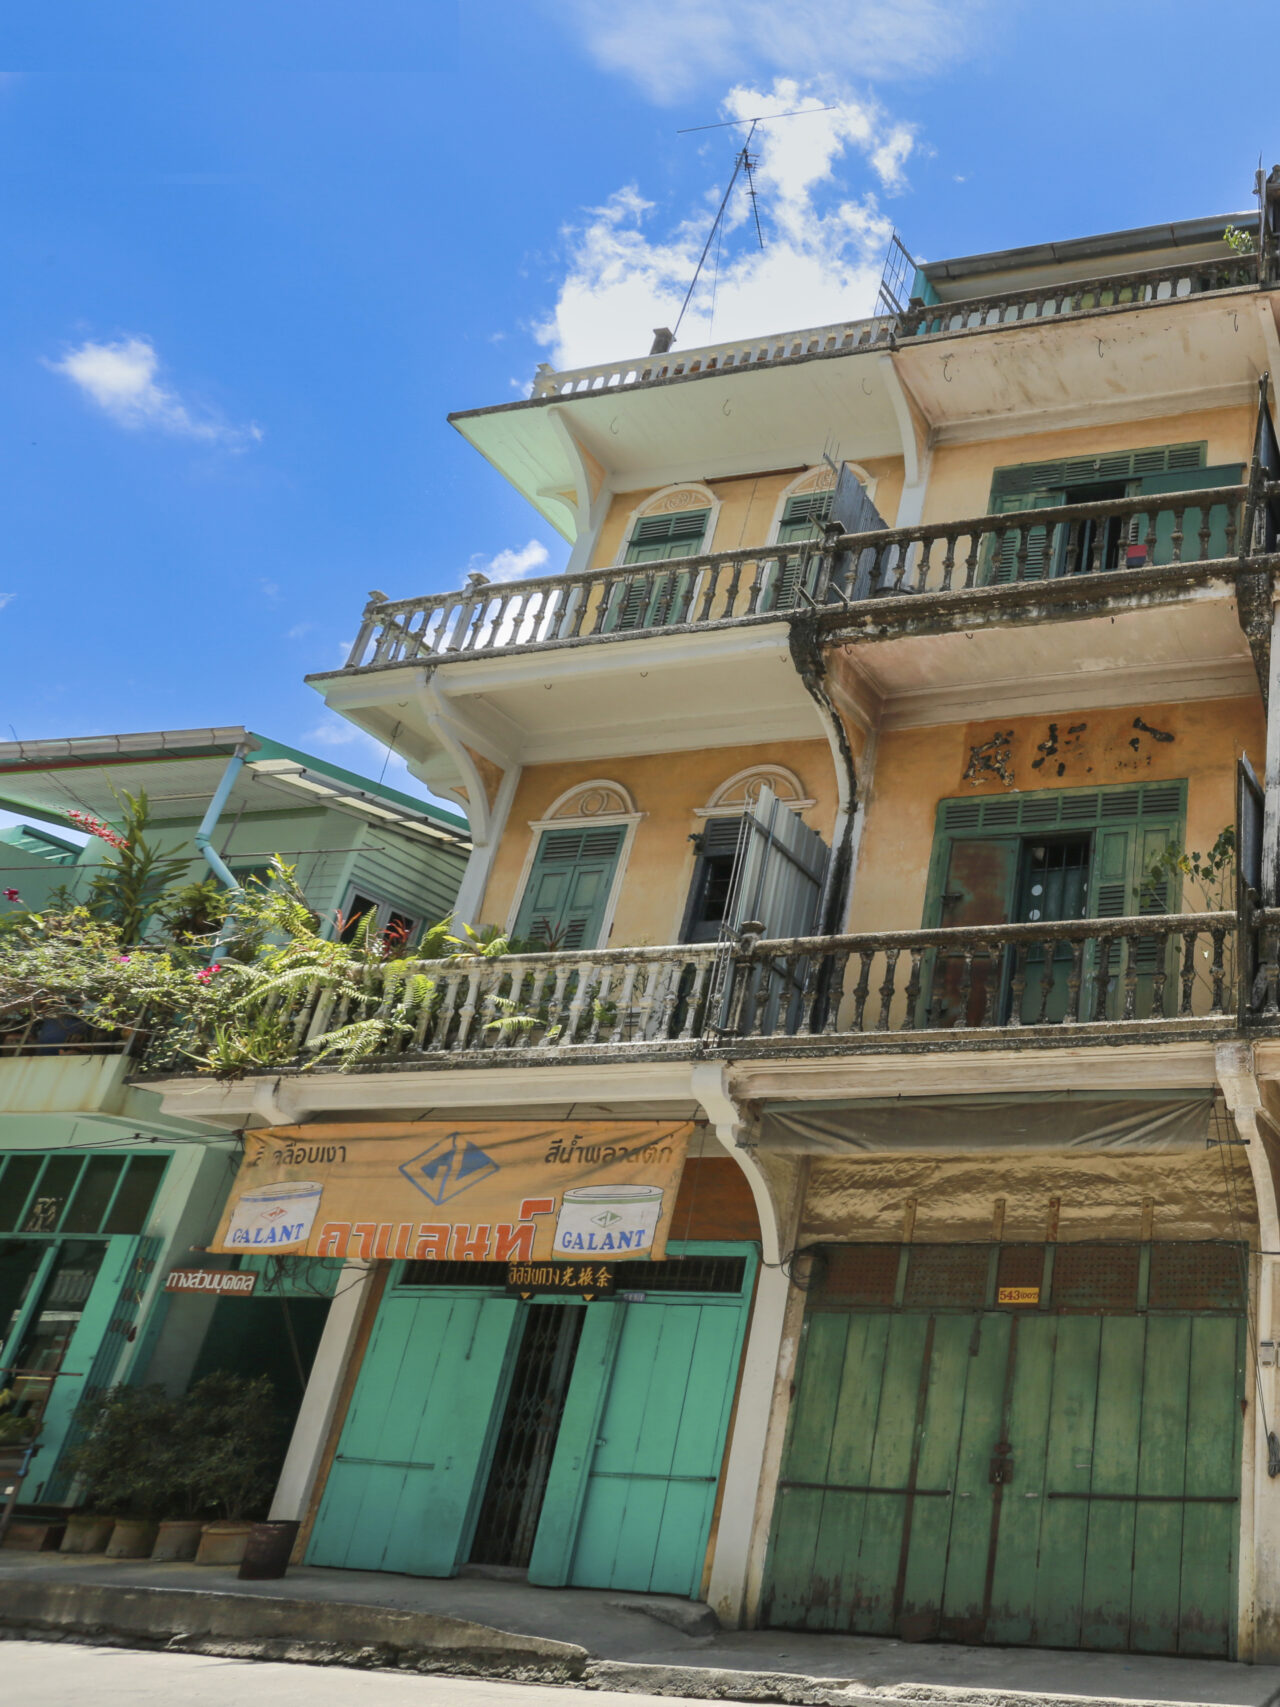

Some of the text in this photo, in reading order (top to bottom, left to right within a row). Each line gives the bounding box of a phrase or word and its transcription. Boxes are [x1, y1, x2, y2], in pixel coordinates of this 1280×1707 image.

[232, 1222, 304, 1245] GALANT
[562, 1229, 646, 1250] GALANT
[166, 1269, 255, 1293] ทางส่วนบุคคล
